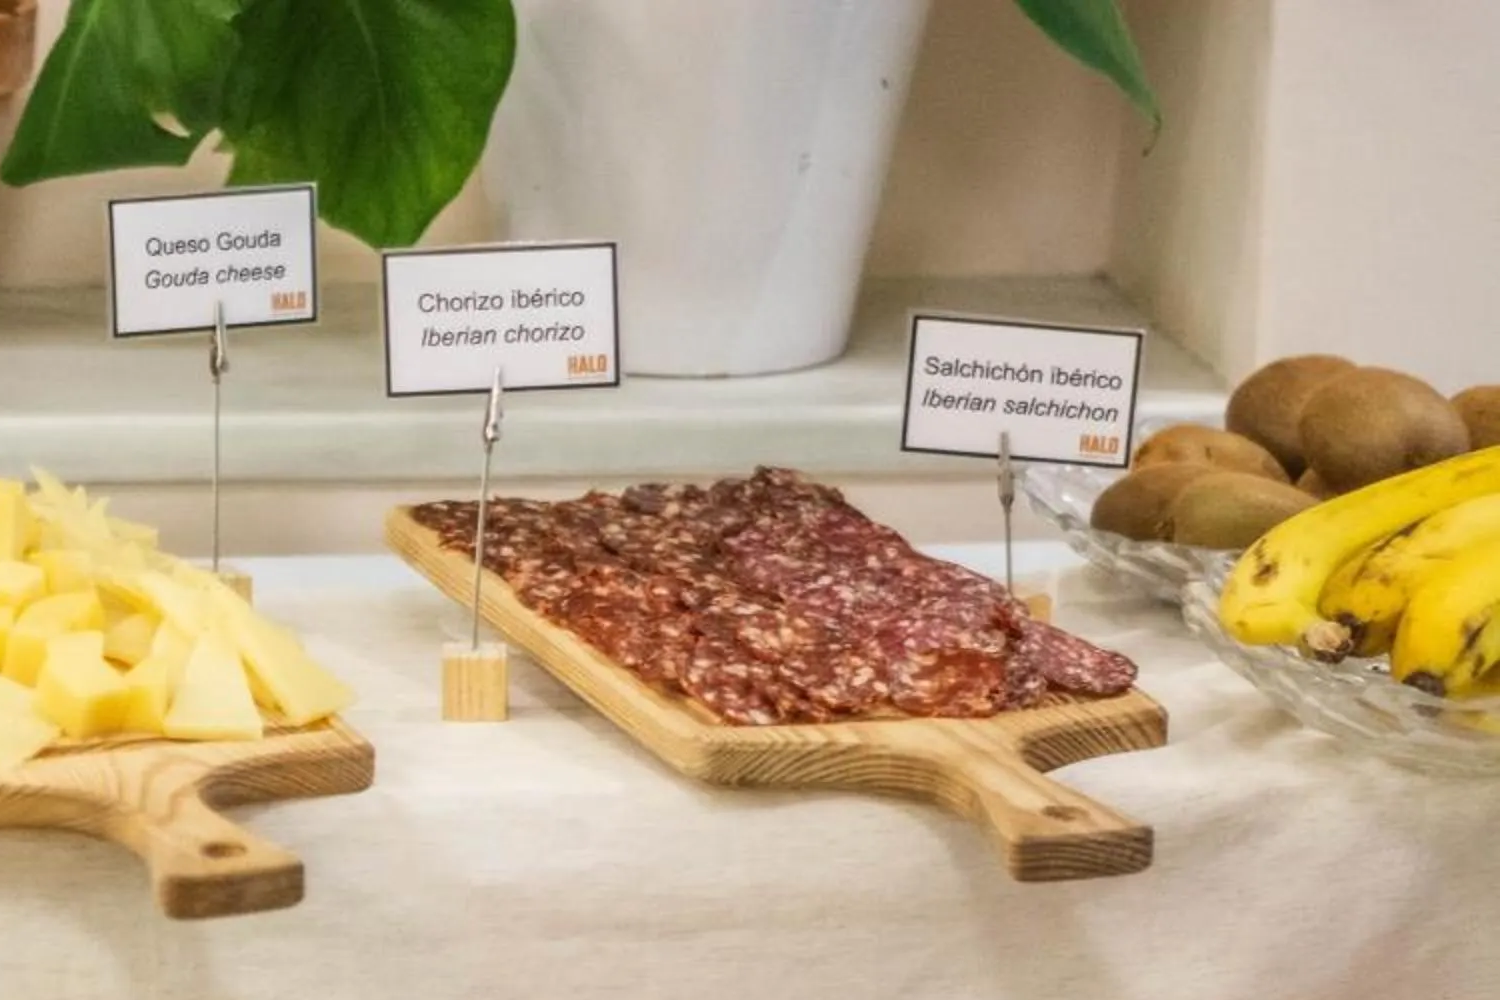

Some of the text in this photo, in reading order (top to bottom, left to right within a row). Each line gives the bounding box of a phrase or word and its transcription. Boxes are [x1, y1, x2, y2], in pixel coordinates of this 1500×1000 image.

[145, 230, 282, 257] Queso Gouda
[145, 264, 286, 289] Gouda cheese
[271, 291, 306, 310] HALO
[418, 288, 585, 313] Chorizo ibérico
[421, 324, 585, 347] Iberian chorizo
[567, 354, 607, 374] HALO
[924, 356, 1122, 390] Salchichón ibérico
[922, 388, 1118, 422] Iberian salchichon
[1079, 434, 1120, 454] HALO
